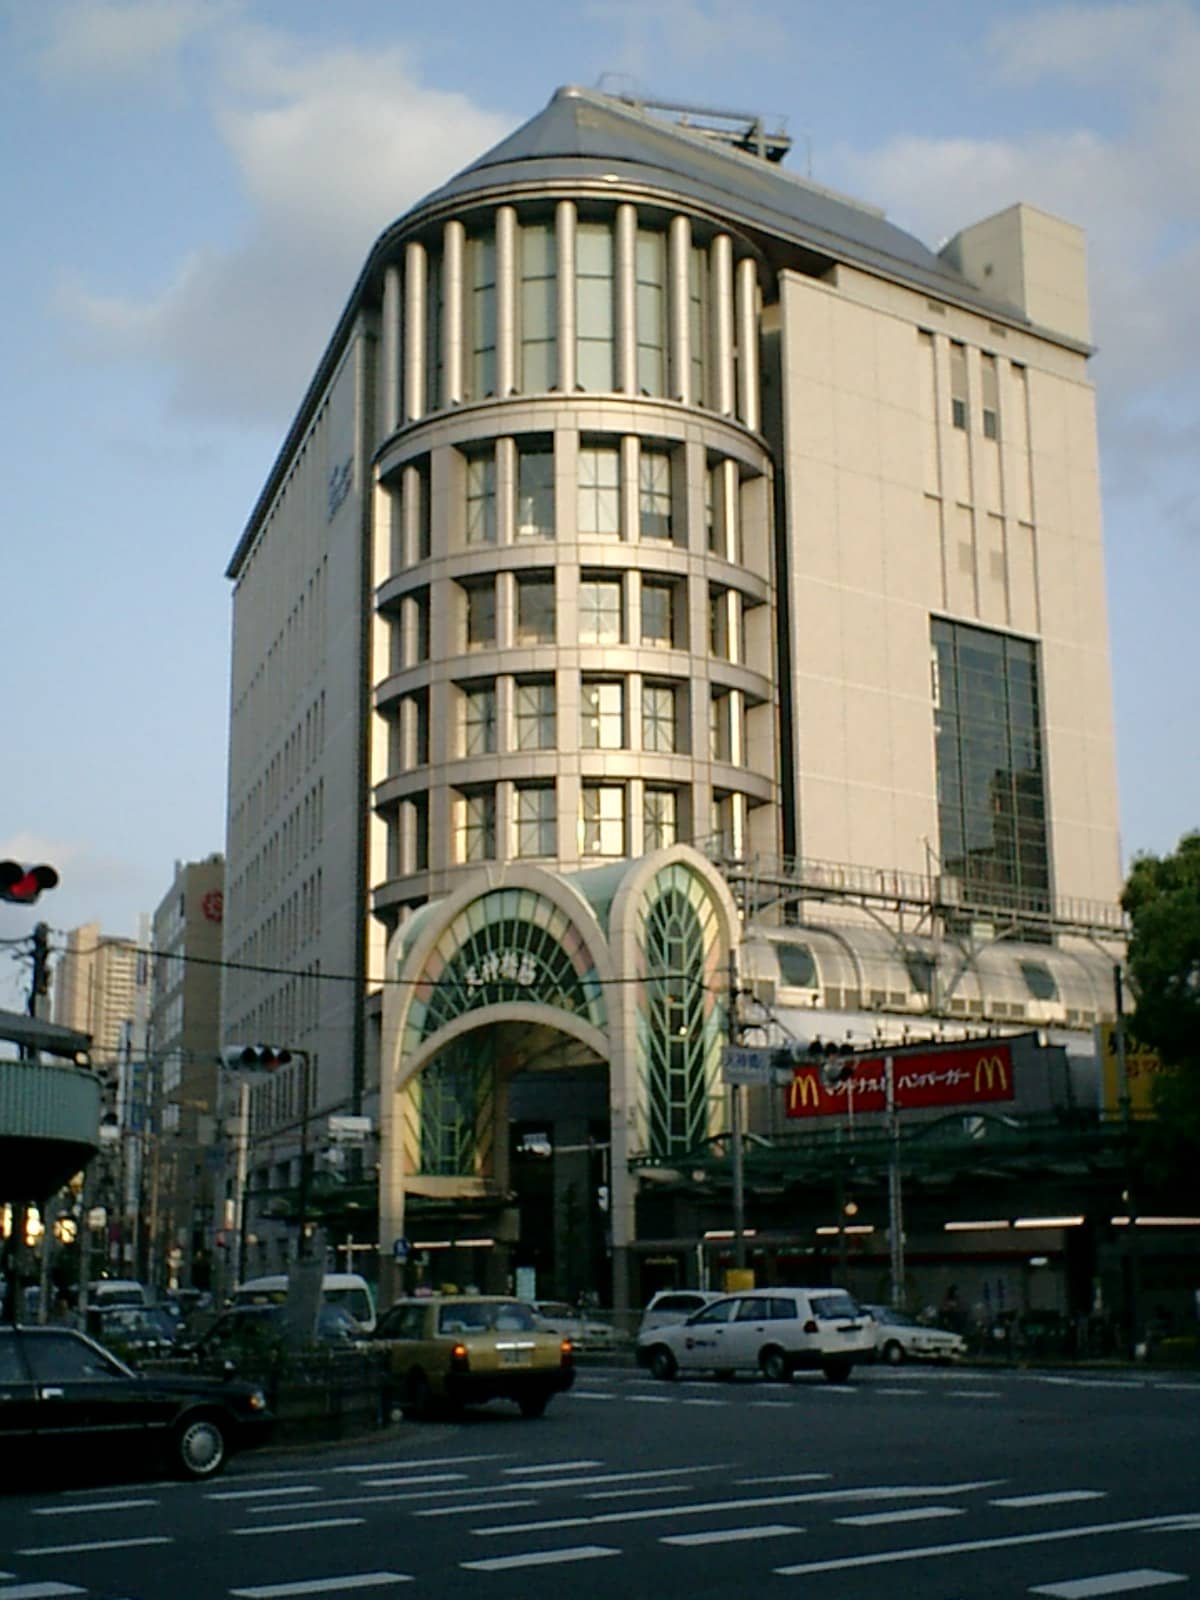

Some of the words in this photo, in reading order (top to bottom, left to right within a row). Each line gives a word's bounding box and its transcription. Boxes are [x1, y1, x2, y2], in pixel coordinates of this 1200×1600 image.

[897, 1067, 971, 1089] ハンバーガー
